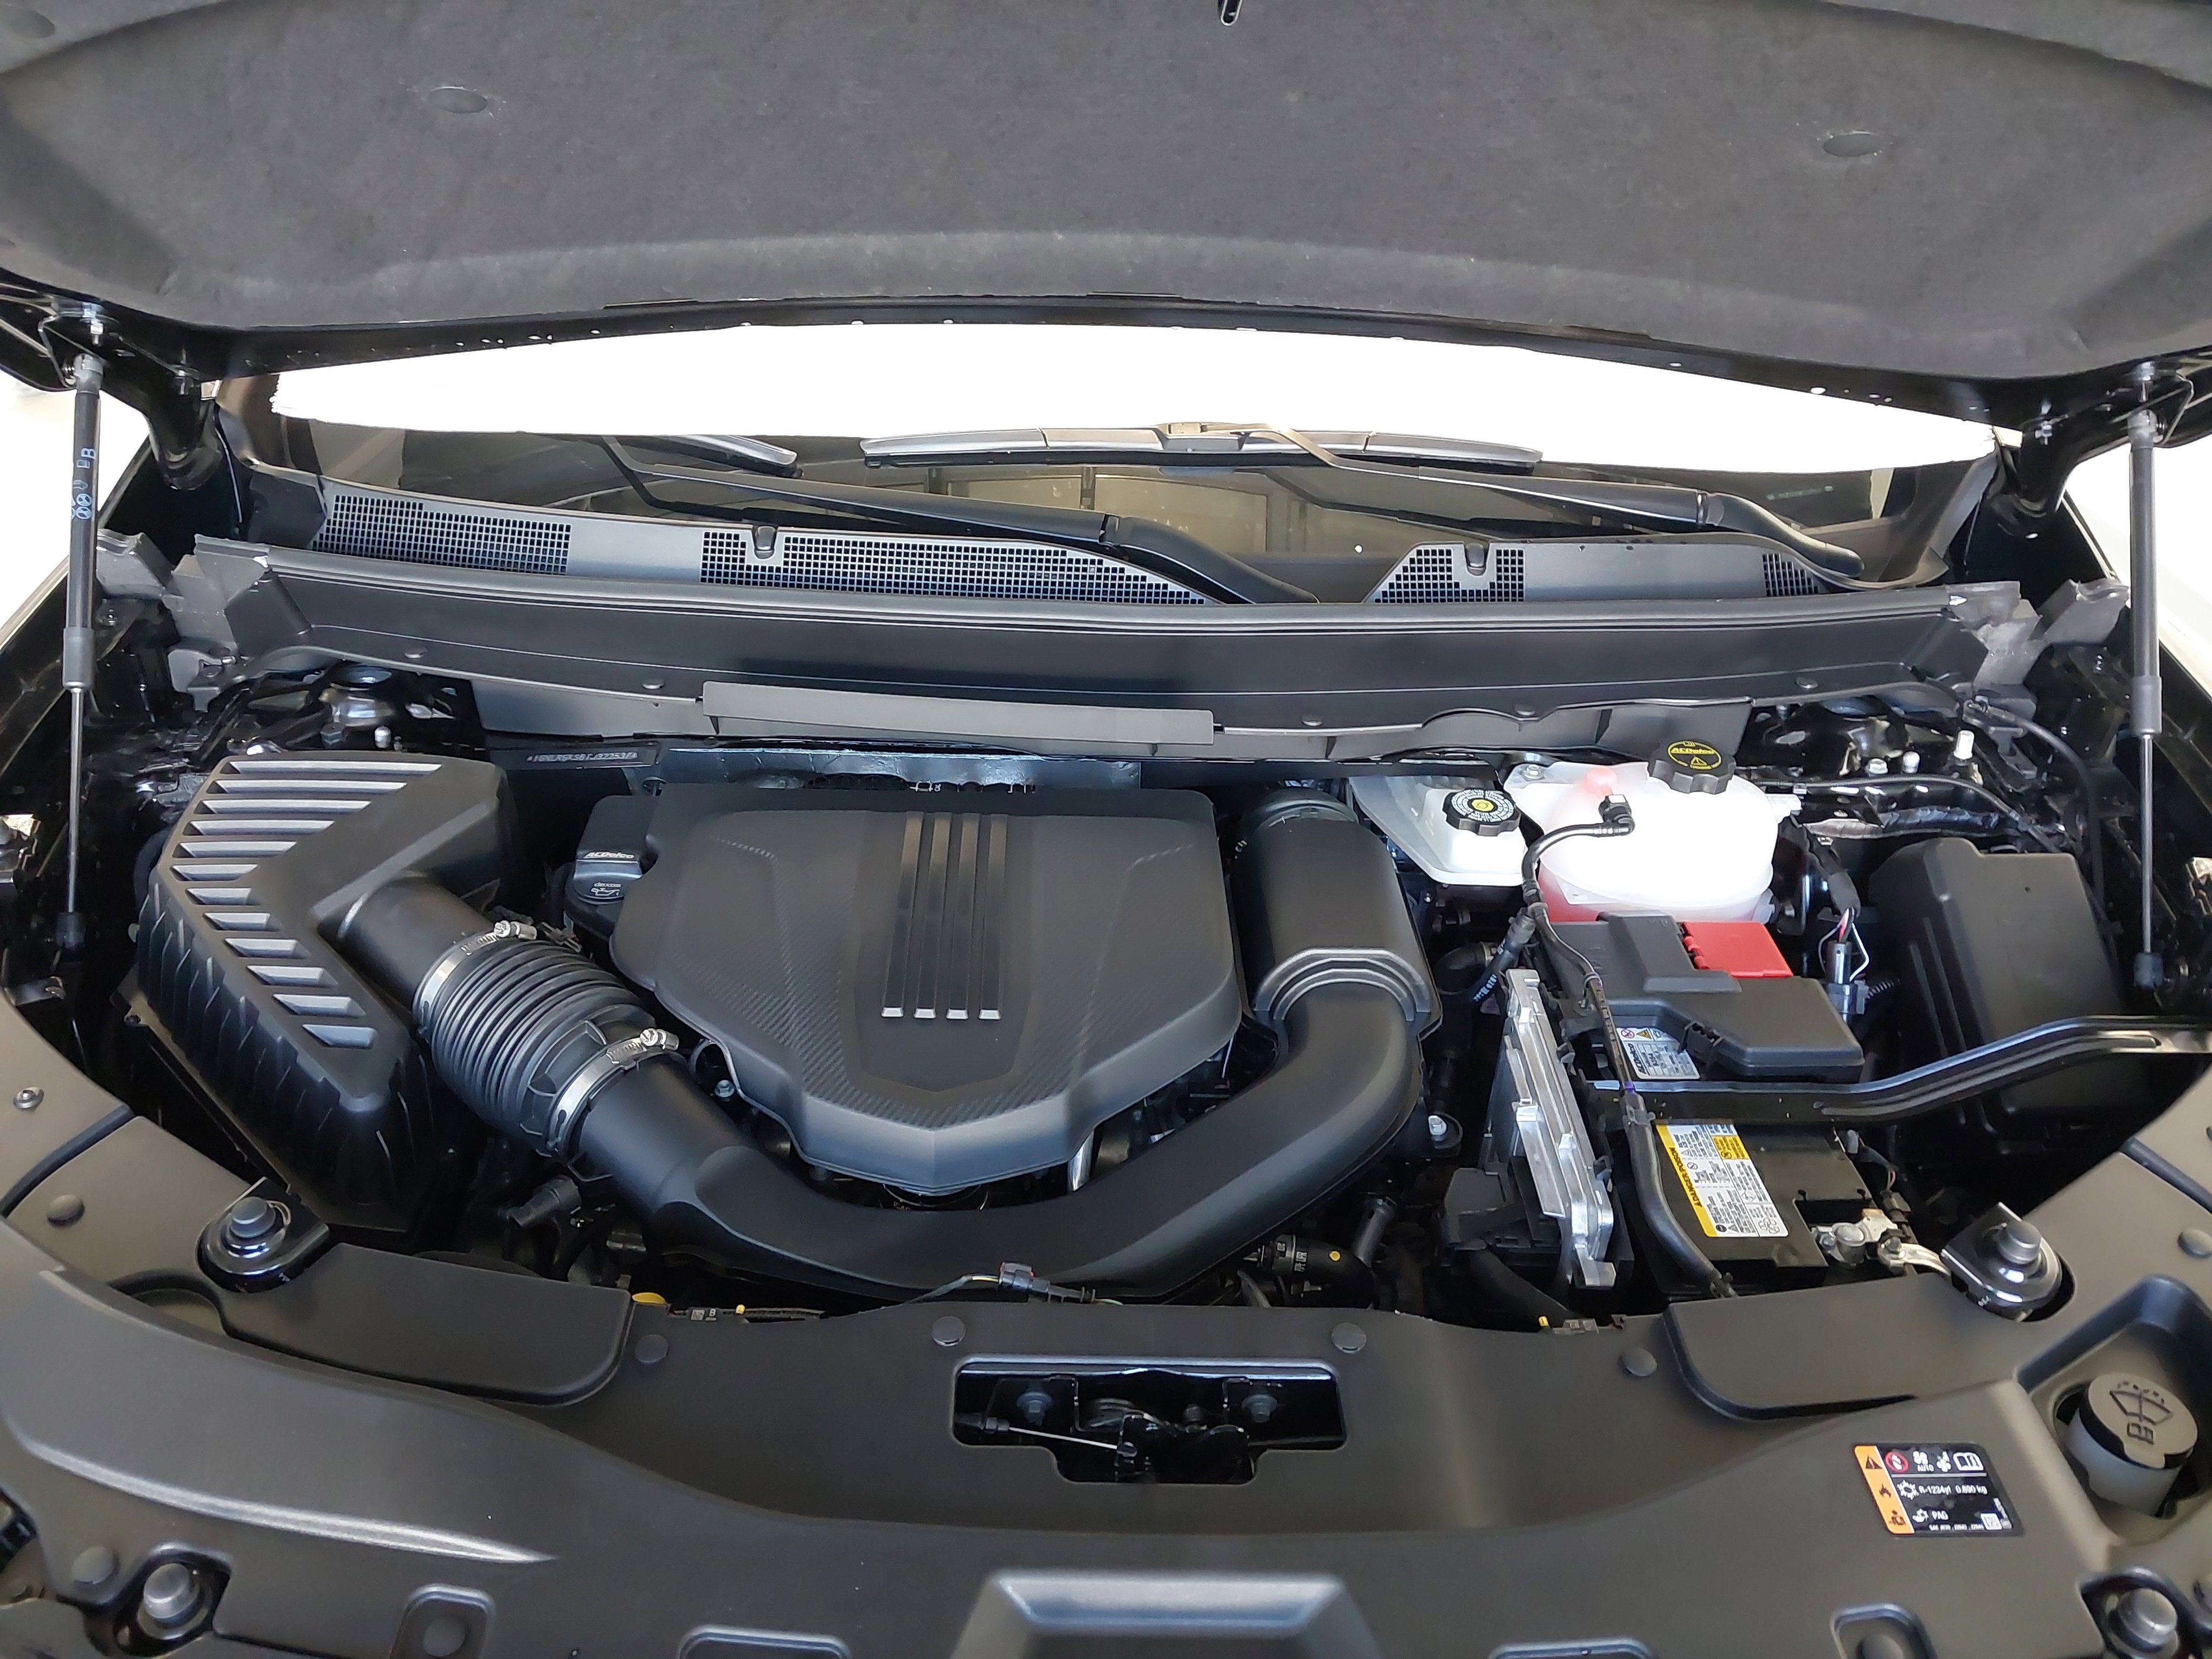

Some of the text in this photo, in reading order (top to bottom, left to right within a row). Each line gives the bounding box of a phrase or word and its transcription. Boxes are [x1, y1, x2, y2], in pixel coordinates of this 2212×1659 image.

[1917, 1464, 1934, 1472] AUTO
[1918, 1485, 1952, 1495] R-1234yf
[1931, 1510, 1949, 1520] PAG
